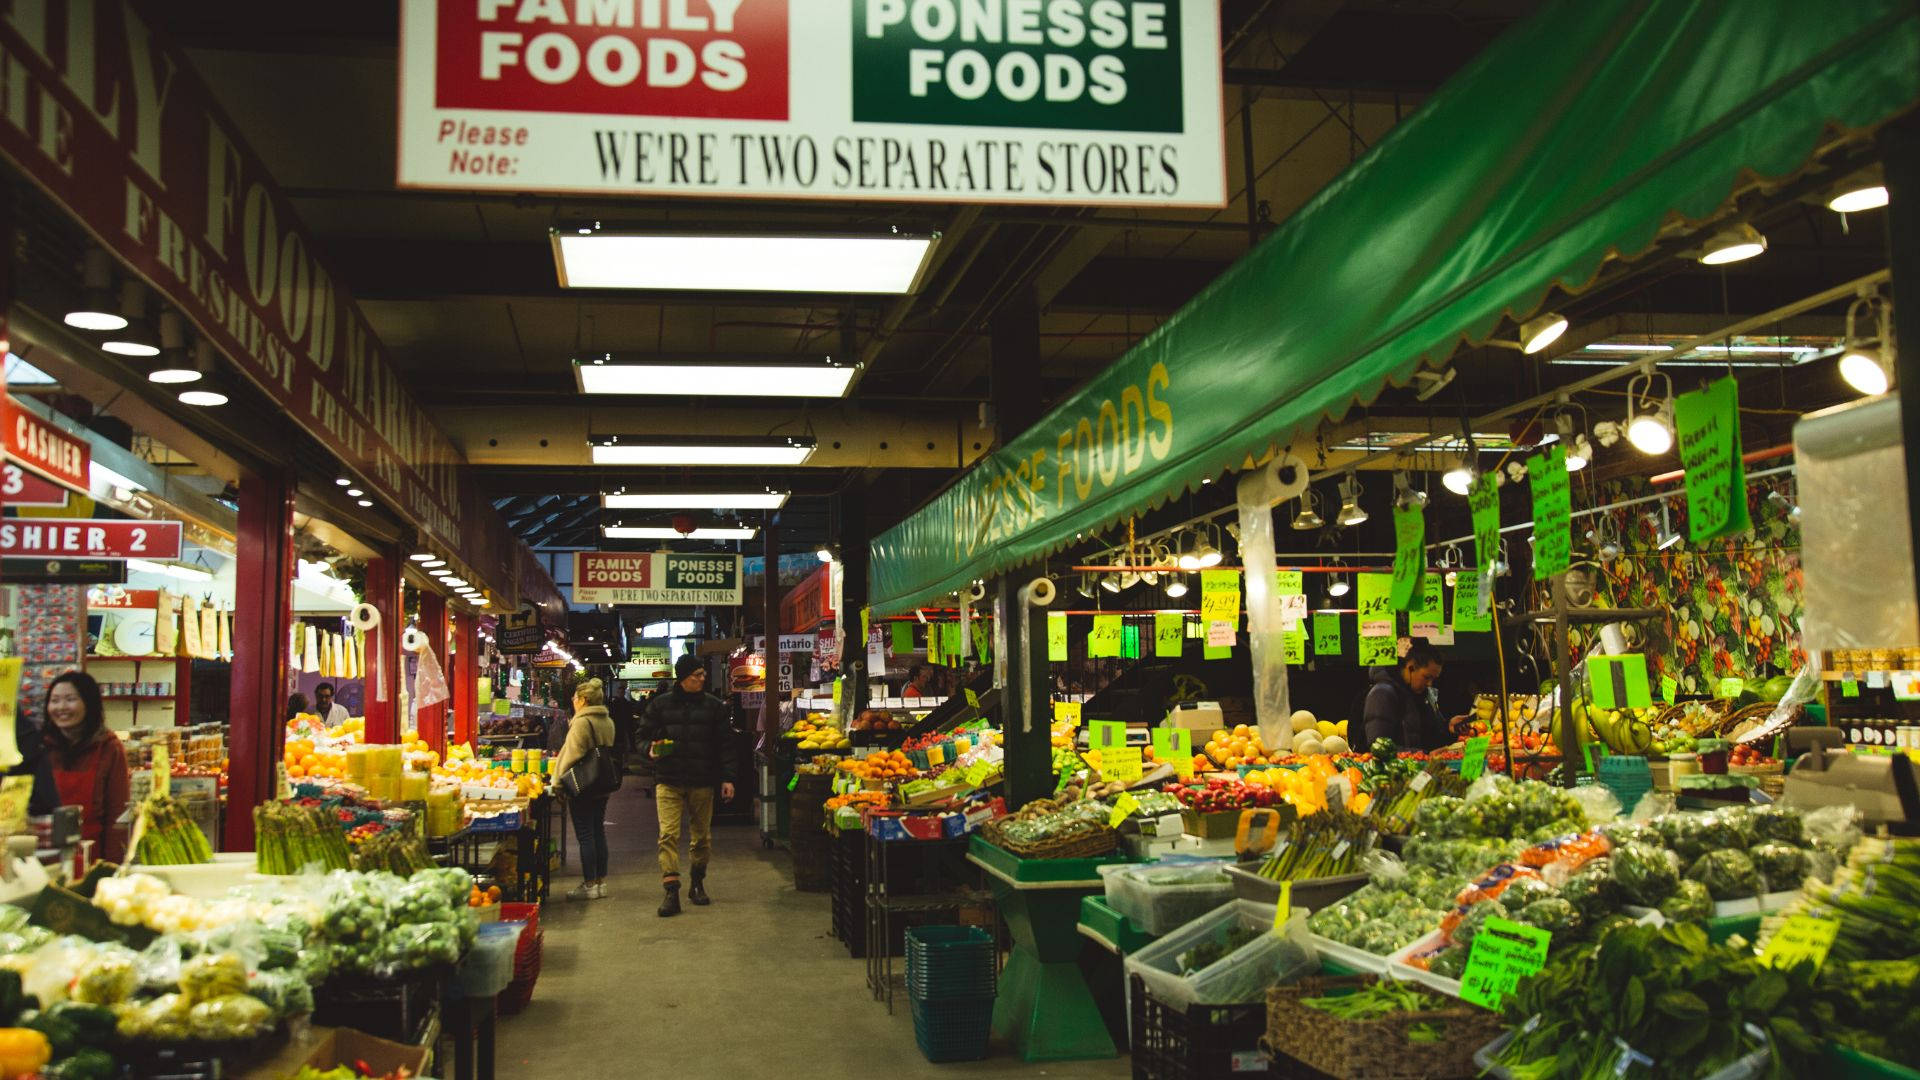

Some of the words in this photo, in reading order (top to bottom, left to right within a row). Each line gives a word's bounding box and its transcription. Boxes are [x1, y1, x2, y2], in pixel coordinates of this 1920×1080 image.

[476, 0, 744, 34] FAMILY
[864, 0, 1169, 50] PONESSE
[480, 33, 749, 92] FOODS
[908, 50, 1129, 105] FOODS
[436, 119, 529, 147] Please
[449, 149, 520, 176] Note:
[593, 128, 719, 187] WE'RE
[730, 132, 820, 189] TWO
[831, 136, 1024, 194] SEPARATE
[1035, 143, 1181, 196] STORES
[203, 112, 336, 373] FOOD
[341, 304, 438, 492] MARKET
[123, 175, 297, 395] FRESHEST
[310, 377, 367, 460] FRUIT
[374, 444, 402, 496] AND
[408, 478, 462, 551] VEGETABLES
[16, 414, 82, 478] CASHIER
[1057, 361, 1174, 510] FOODS
[2, 464, 24, 495] 3
[130, 528, 148, 551] 2
[586, 558, 643, 570] FAMILY
[587, 571, 643, 582] FOODS
[668, 560, 734, 572] PONESSE
[677, 572, 724, 584] FOODS
[612, 589, 638, 602] WE'RE
[640, 589, 659, 602] TWO
[660, 589, 700, 602] SEPARATE
[703, 589, 735, 603] STORES
[632, 657, 671, 665] CHEESE
